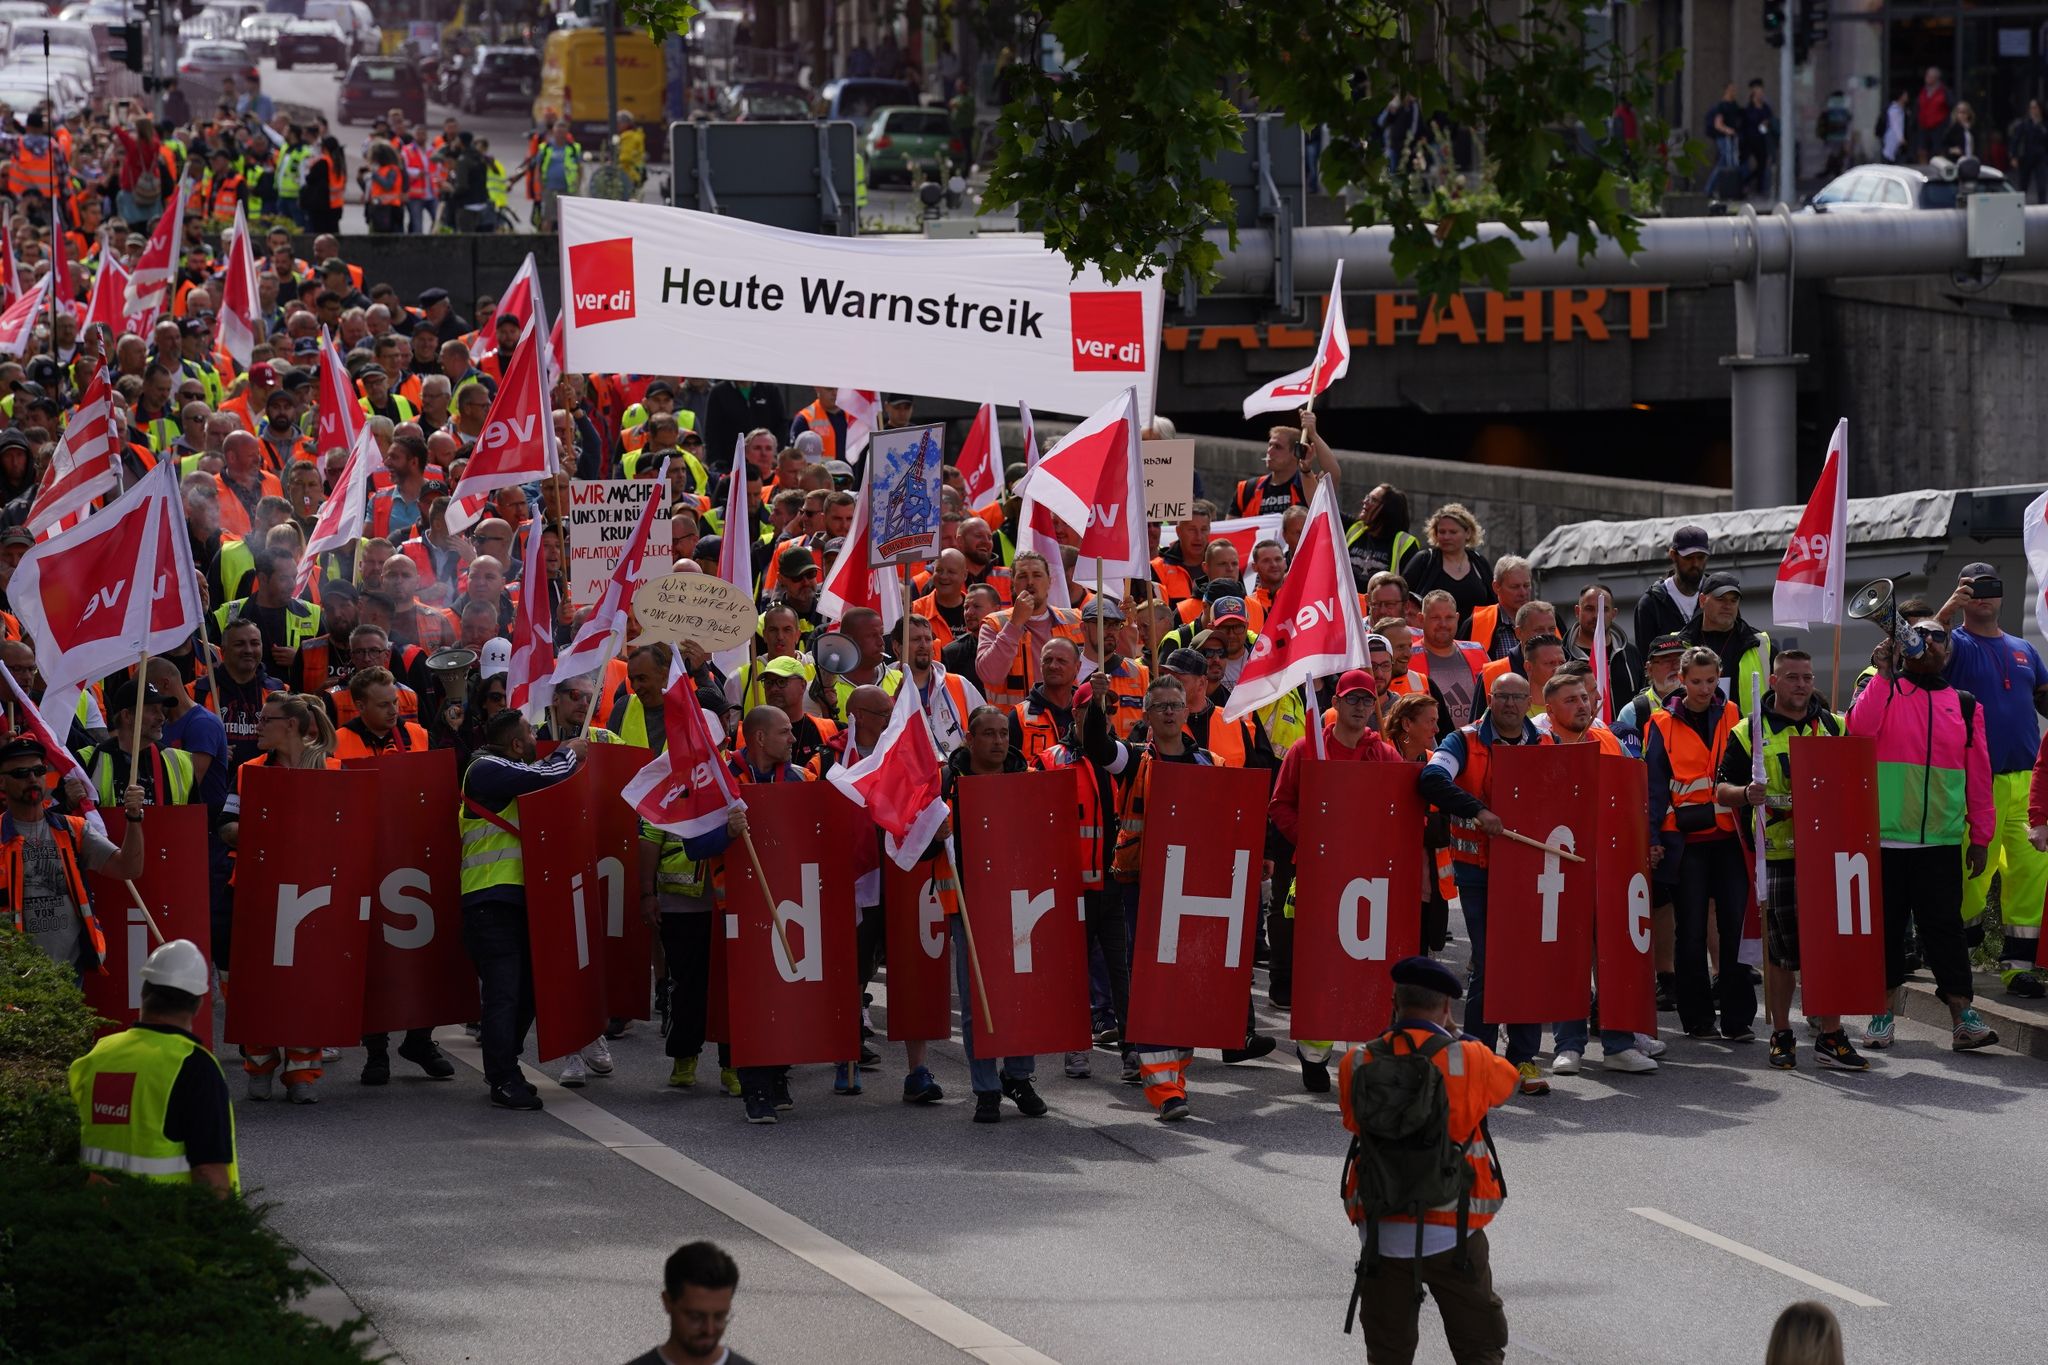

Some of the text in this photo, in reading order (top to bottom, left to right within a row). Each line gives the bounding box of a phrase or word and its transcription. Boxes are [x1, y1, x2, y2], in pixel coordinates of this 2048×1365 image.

[576, 290, 631, 311] ver.di
[661, 267, 1044, 339] Heute Warnstreik
[1076, 338, 1141, 364] ver.di
[571, 484, 605, 504] WIR
[572, 510, 597, 524] UNS
[598, 509, 622, 523] DEN
[658, 592, 687, 603] DER
[379, 868, 435, 949] s
[572, 872, 589, 970] i
[1157, 845, 1250, 968] H
[1338, 877, 1389, 960] a
[1627, 872, 1651, 954] e
[1834, 852, 1872, 935] n
[94, 1102, 129, 1117] ver.di
